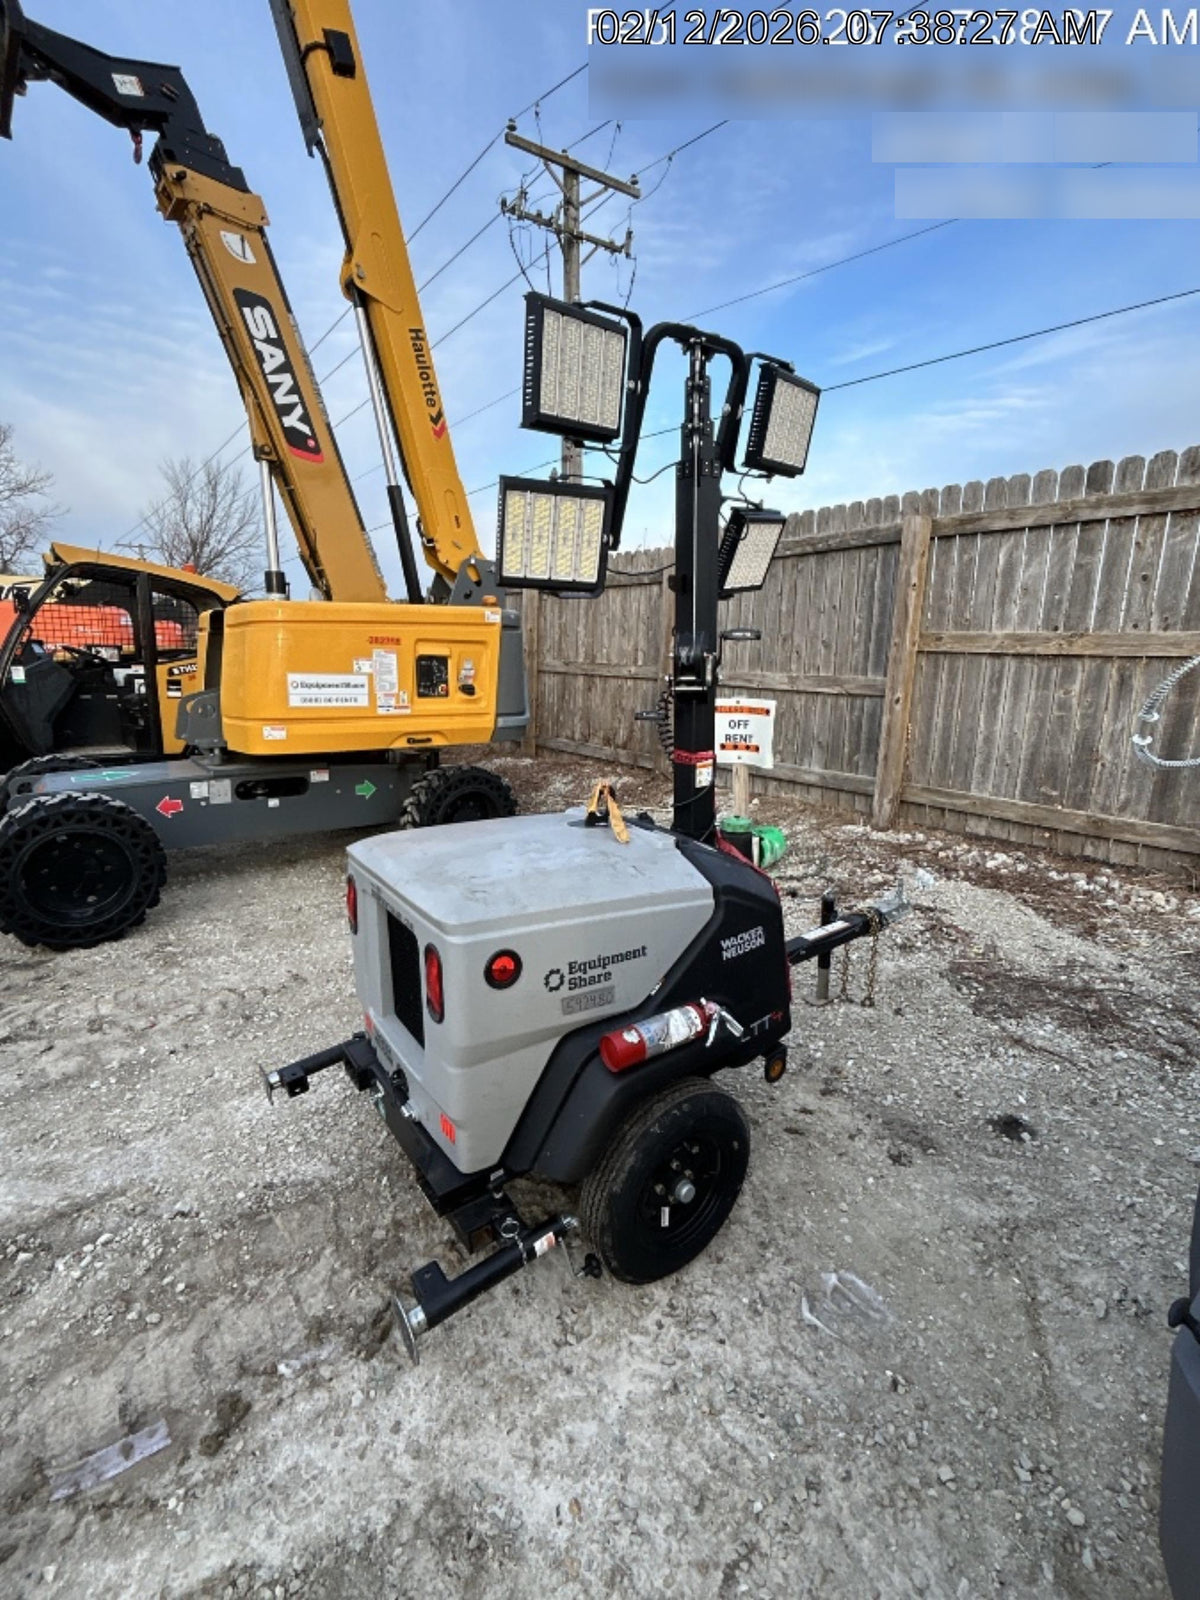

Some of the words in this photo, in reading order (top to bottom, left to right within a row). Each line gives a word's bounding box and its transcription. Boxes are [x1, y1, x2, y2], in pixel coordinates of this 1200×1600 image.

[241, 304, 313, 437] SANY
[408, 327, 438, 409] Haulotte
[728, 719, 750, 729] OFF
[725, 733, 753, 743] RENT
[720, 925, 764, 950] WACKER
[721, 932, 766, 961] NEUSON
[568, 945, 648, 975] Equipment
[568, 971, 613, 991] Share
